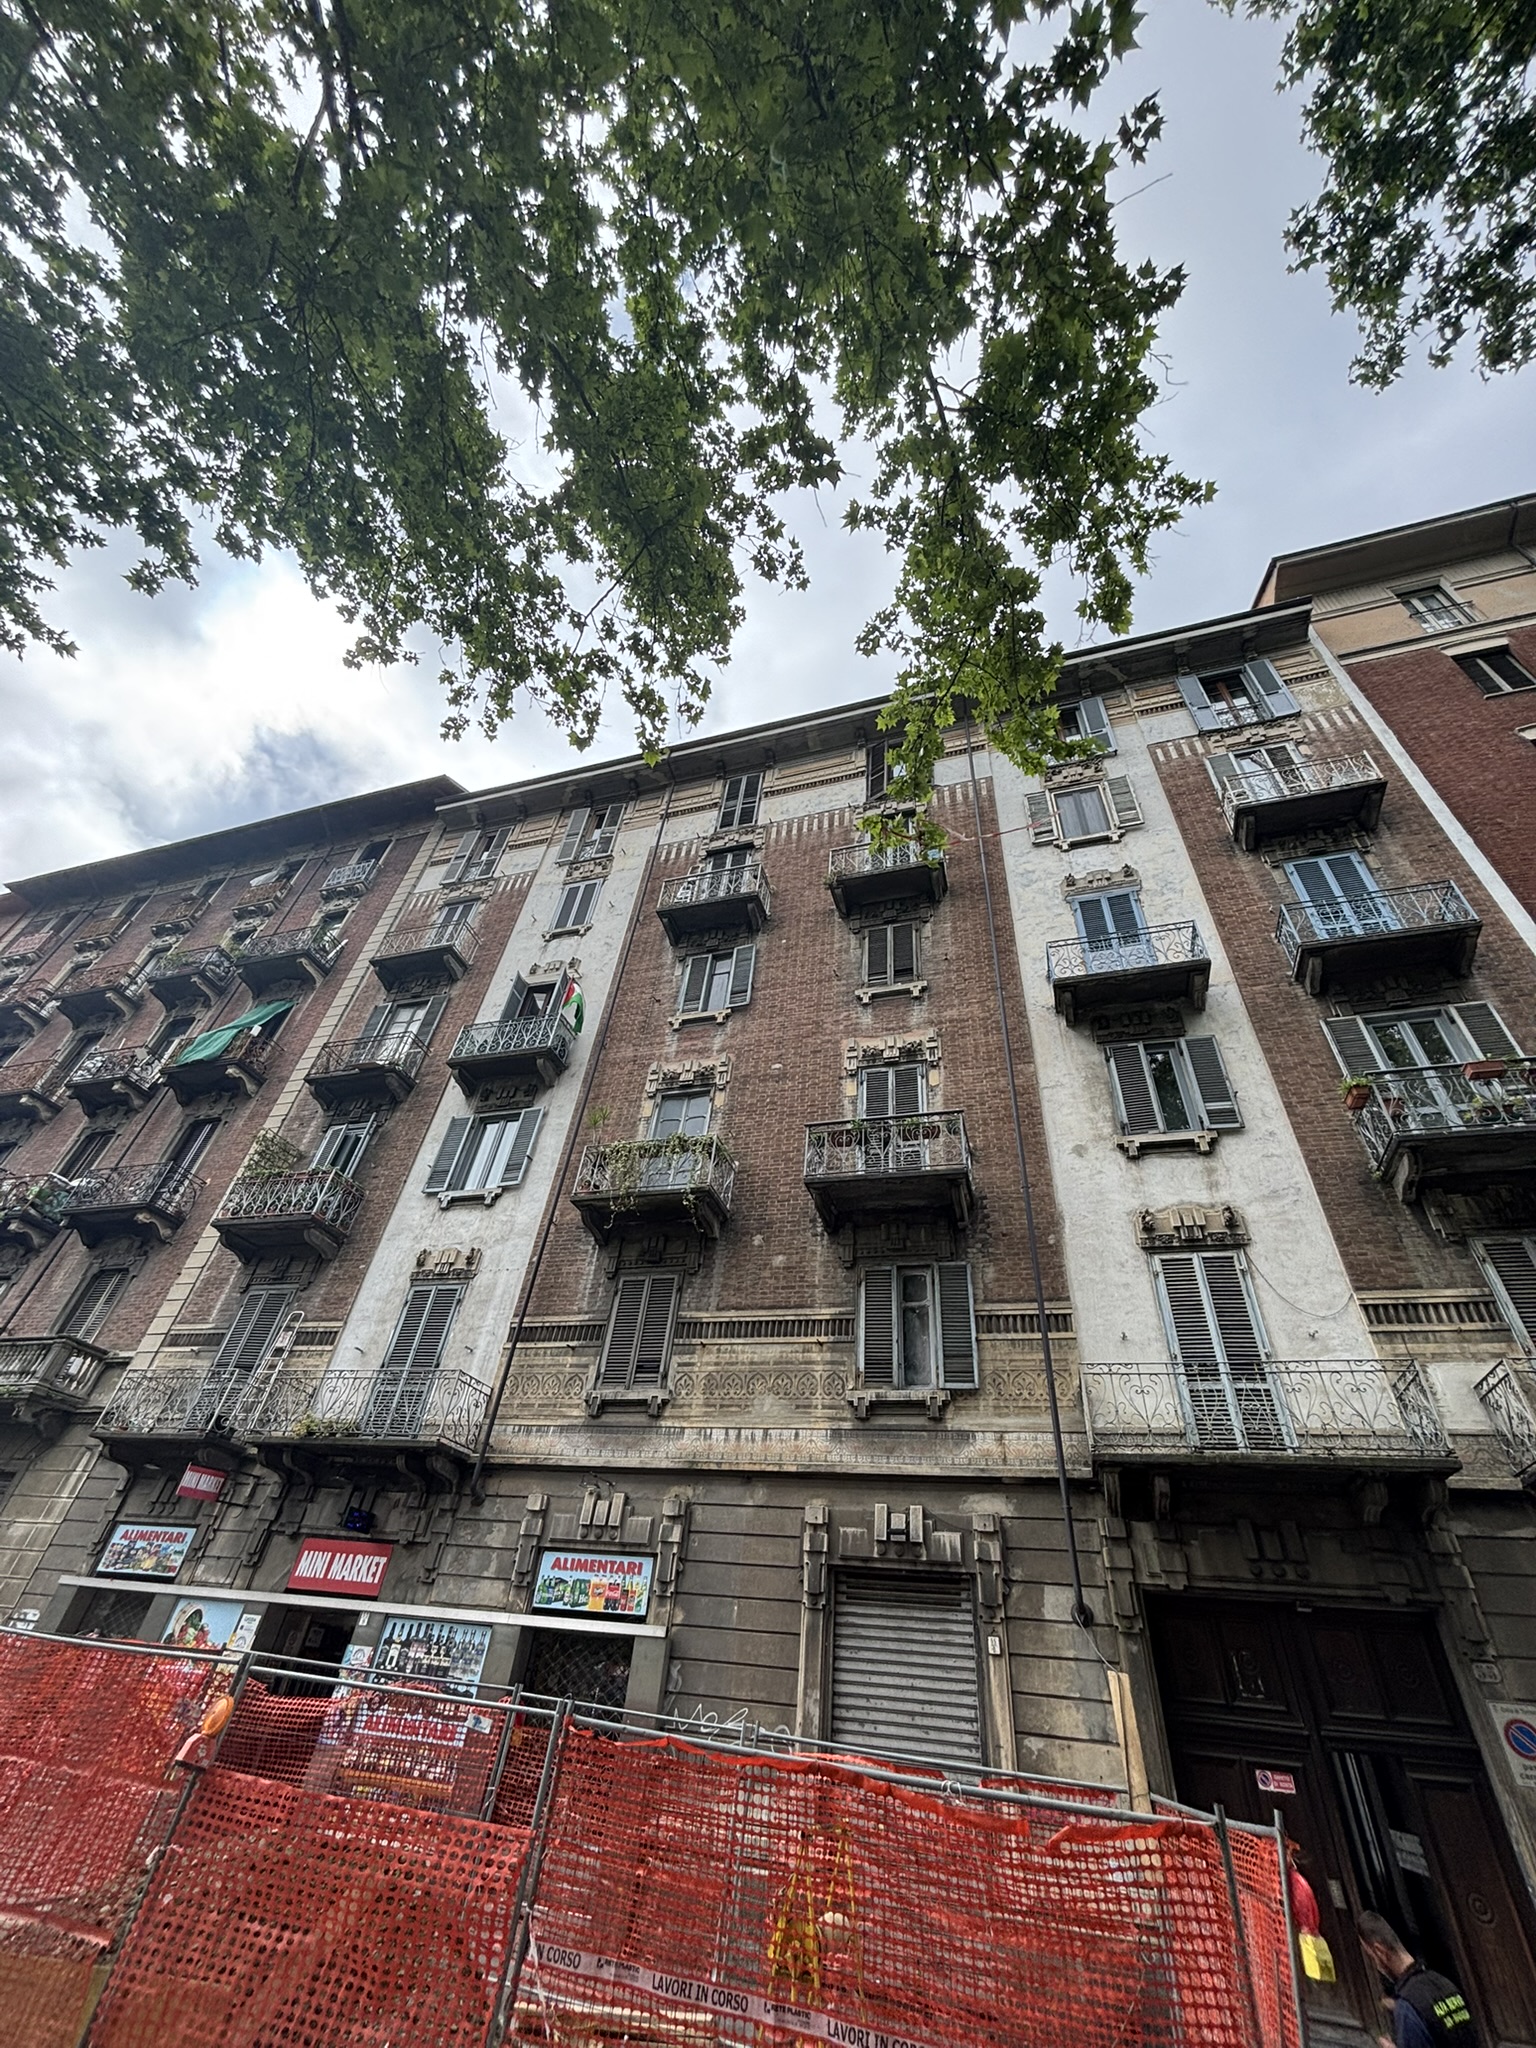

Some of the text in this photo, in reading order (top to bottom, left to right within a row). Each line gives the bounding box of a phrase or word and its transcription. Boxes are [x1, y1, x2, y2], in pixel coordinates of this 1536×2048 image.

[120, 1529, 188, 1544] ALIMENTARI
[294, 1550, 388, 1584] MINI MARKET
[550, 1556, 644, 1576] ALIMENTARI
[547, 1946, 581, 1969] CORSO
[652, 1973, 749, 2013] LAVORI IN CORSO
[827, 2019, 870, 2048] LAVORI
[874, 2034, 888, 2048] IN
